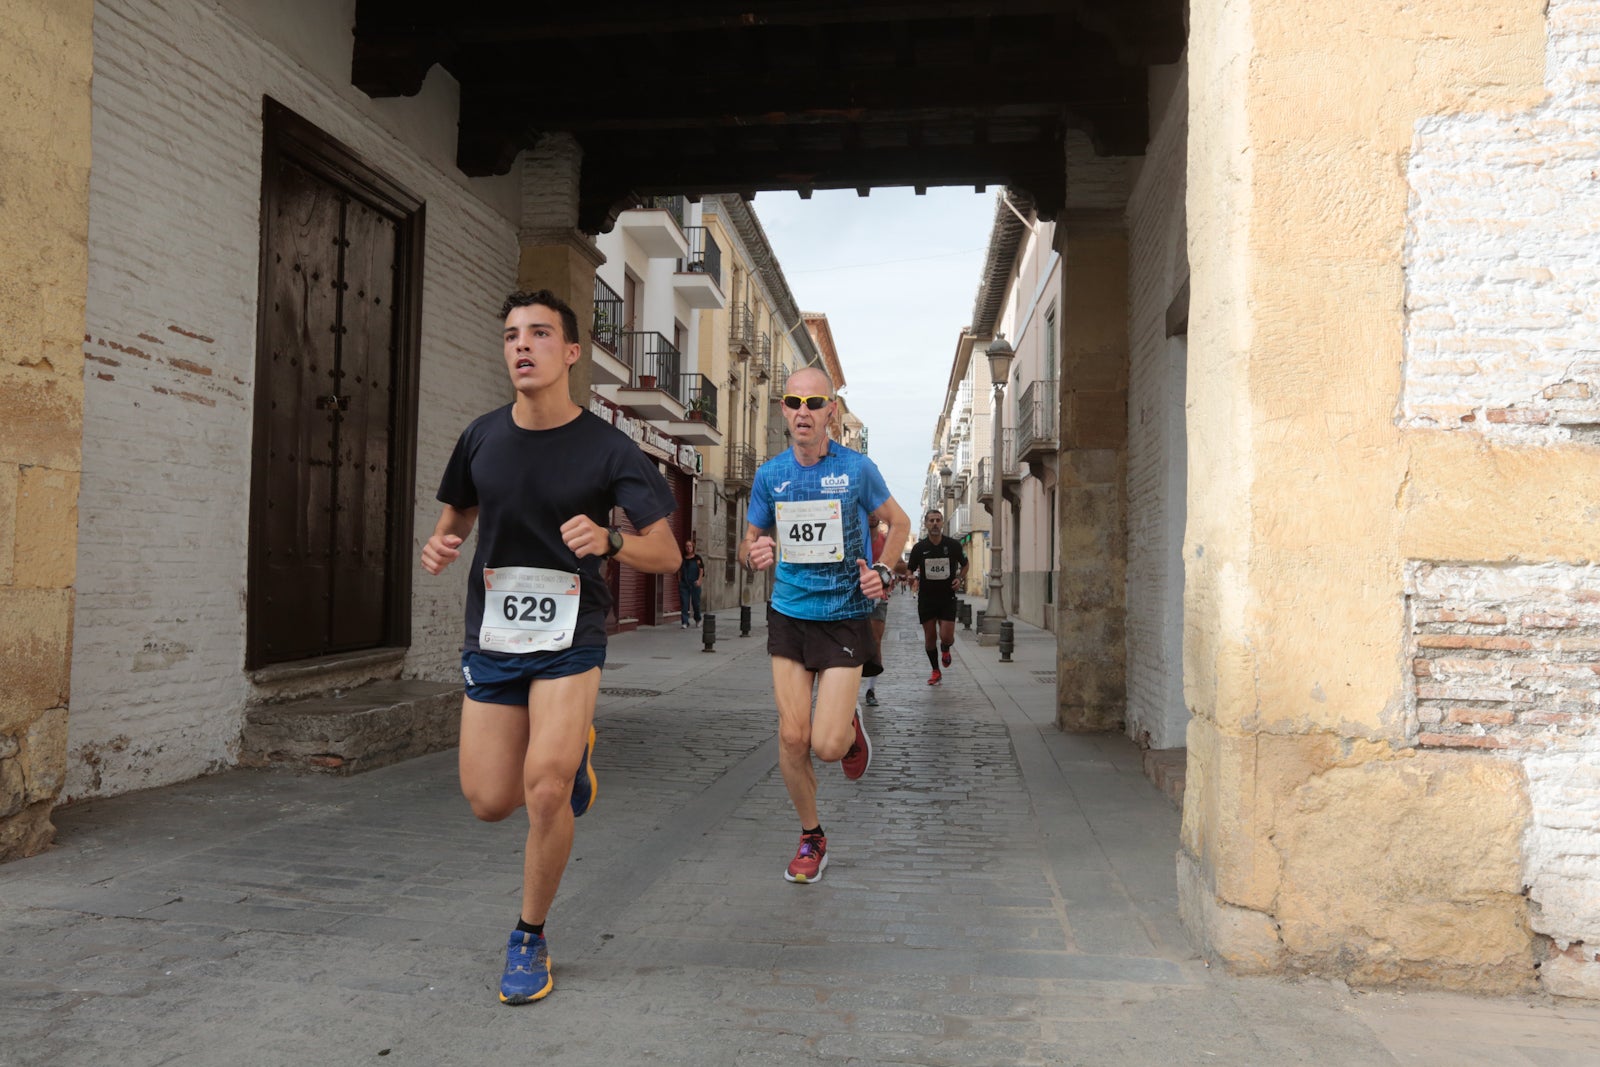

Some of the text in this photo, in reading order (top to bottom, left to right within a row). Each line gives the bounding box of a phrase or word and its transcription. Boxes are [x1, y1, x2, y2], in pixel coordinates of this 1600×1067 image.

[824, 478, 845, 486] LOJA
[789, 522, 827, 542] 487
[930, 565, 945, 573] 484
[503, 595, 557, 623] 629
